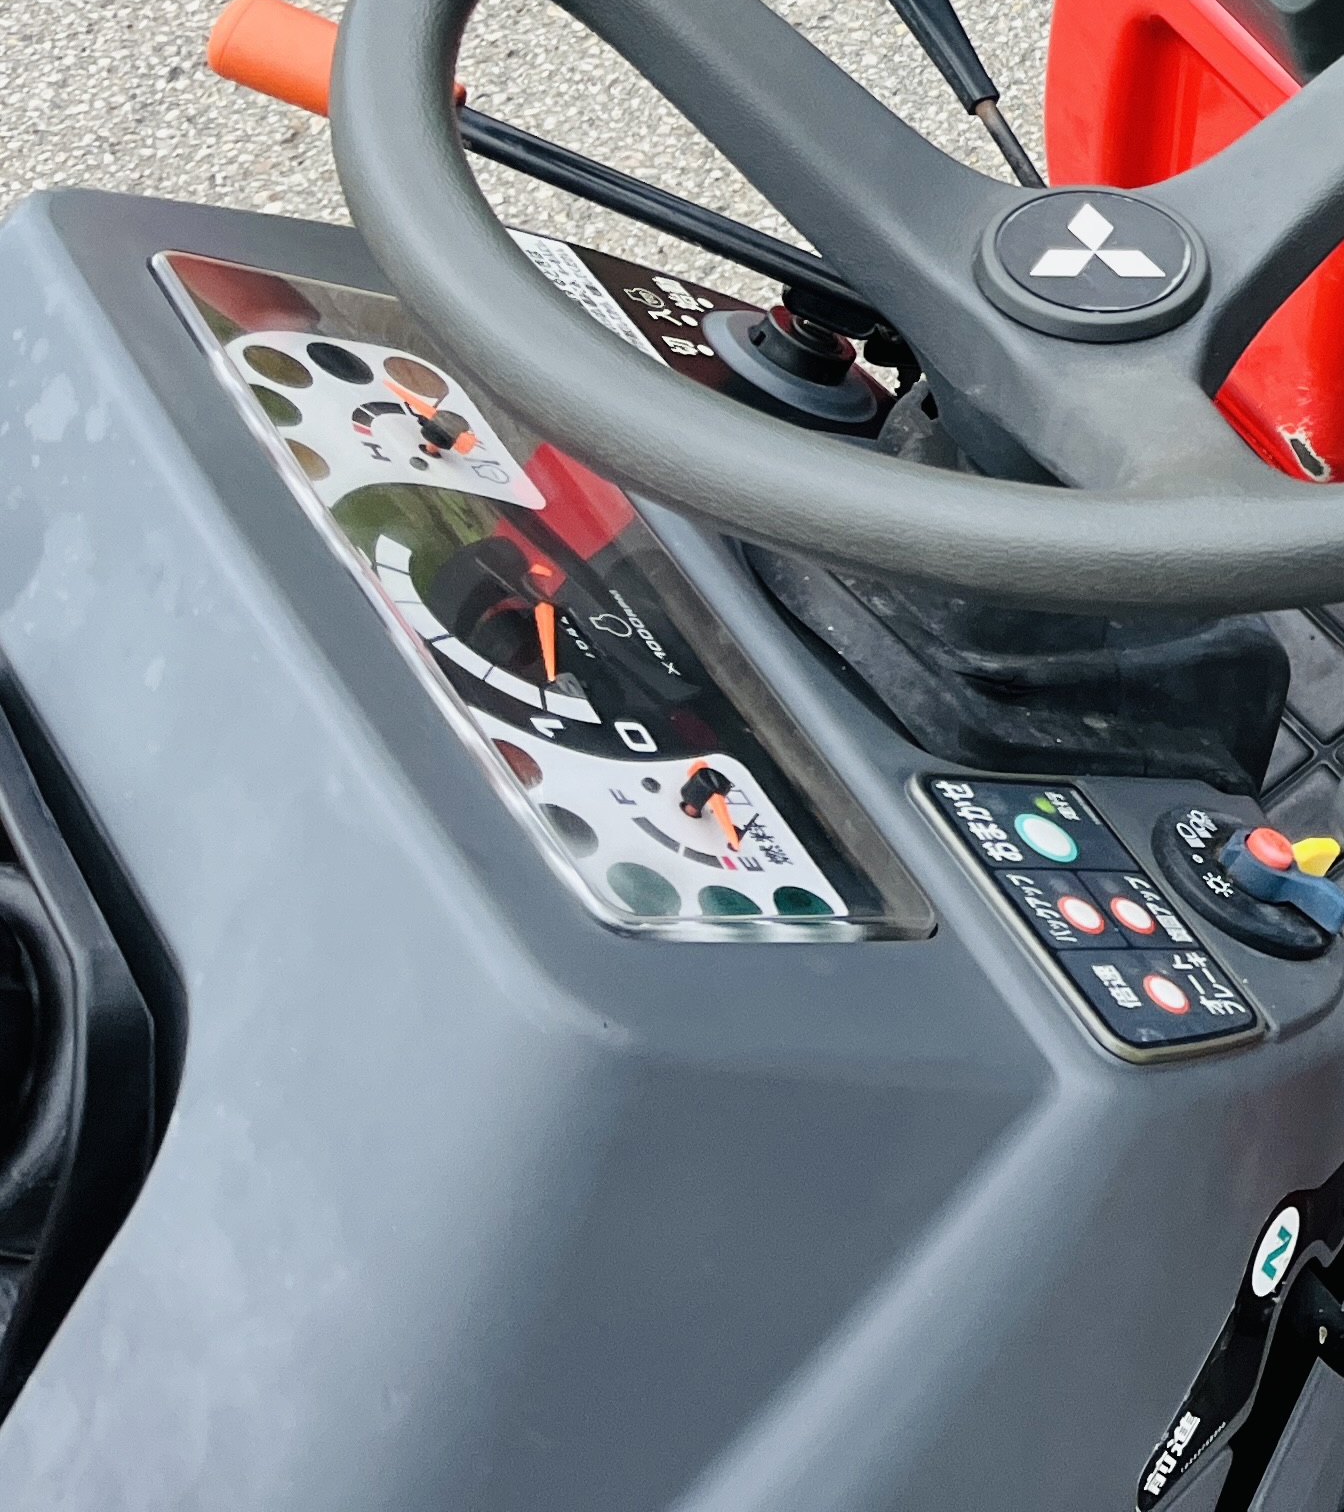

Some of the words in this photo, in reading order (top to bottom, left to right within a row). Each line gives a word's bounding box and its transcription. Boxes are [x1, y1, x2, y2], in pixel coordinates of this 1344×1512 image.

[648, 309, 683, 326] 入
[361, 441, 392, 463] H
[530, 717, 566, 738] 1
[614, 721, 658, 752] 0
[609, 788, 637, 806] F
[936, 780, 1023, 862] おまかせ
[737, 856, 765, 872] E
[1006, 874, 1077, 944] バックアップ
[1092, 964, 1142, 1008] 倍速
[1172, 953, 1223, 1015] オート
[1261, 1225, 1292, 1281] N
[1143, 1411, 1200, 1496] 前進
